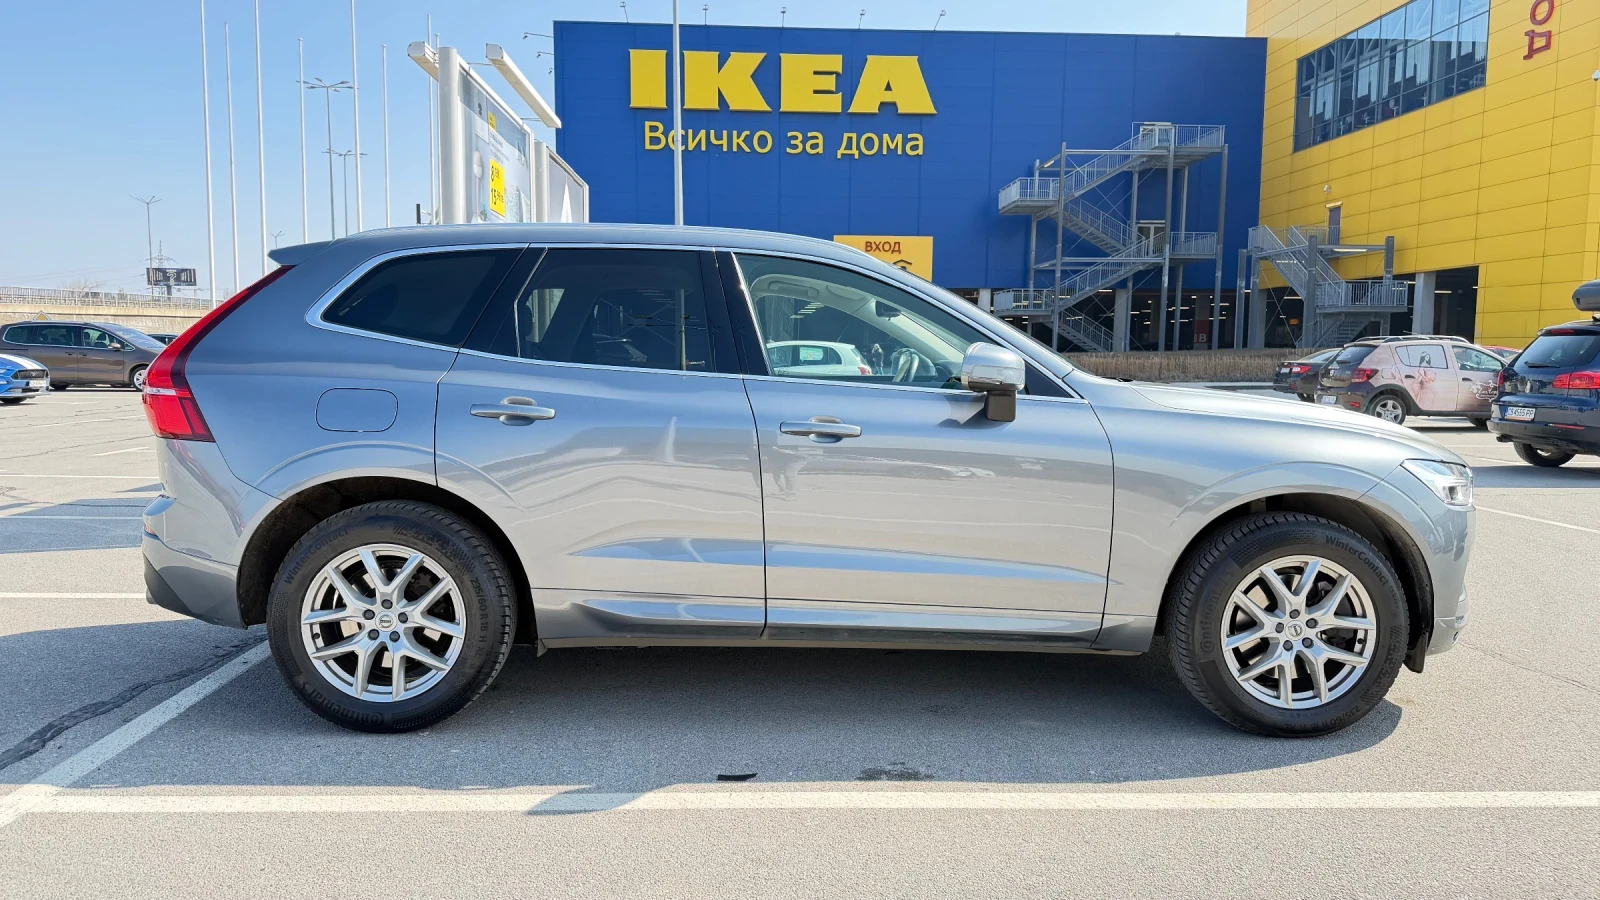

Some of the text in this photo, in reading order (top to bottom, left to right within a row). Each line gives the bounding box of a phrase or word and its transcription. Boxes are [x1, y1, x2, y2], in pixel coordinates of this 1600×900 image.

[628, 49, 937, 115] IKEA
[644, 121, 924, 159] Всичко за дома
[865, 241, 902, 254] ВХОД
[282, 528, 349, 585] WinterContact
[1323, 534, 1390, 586] WinterContact
[469, 576, 488, 611] 235/60
[479, 612, 488, 620] R
[479, 621, 488, 632] 18
[477, 634, 488, 644] H
[1328, 704, 1362, 727] 235/60
